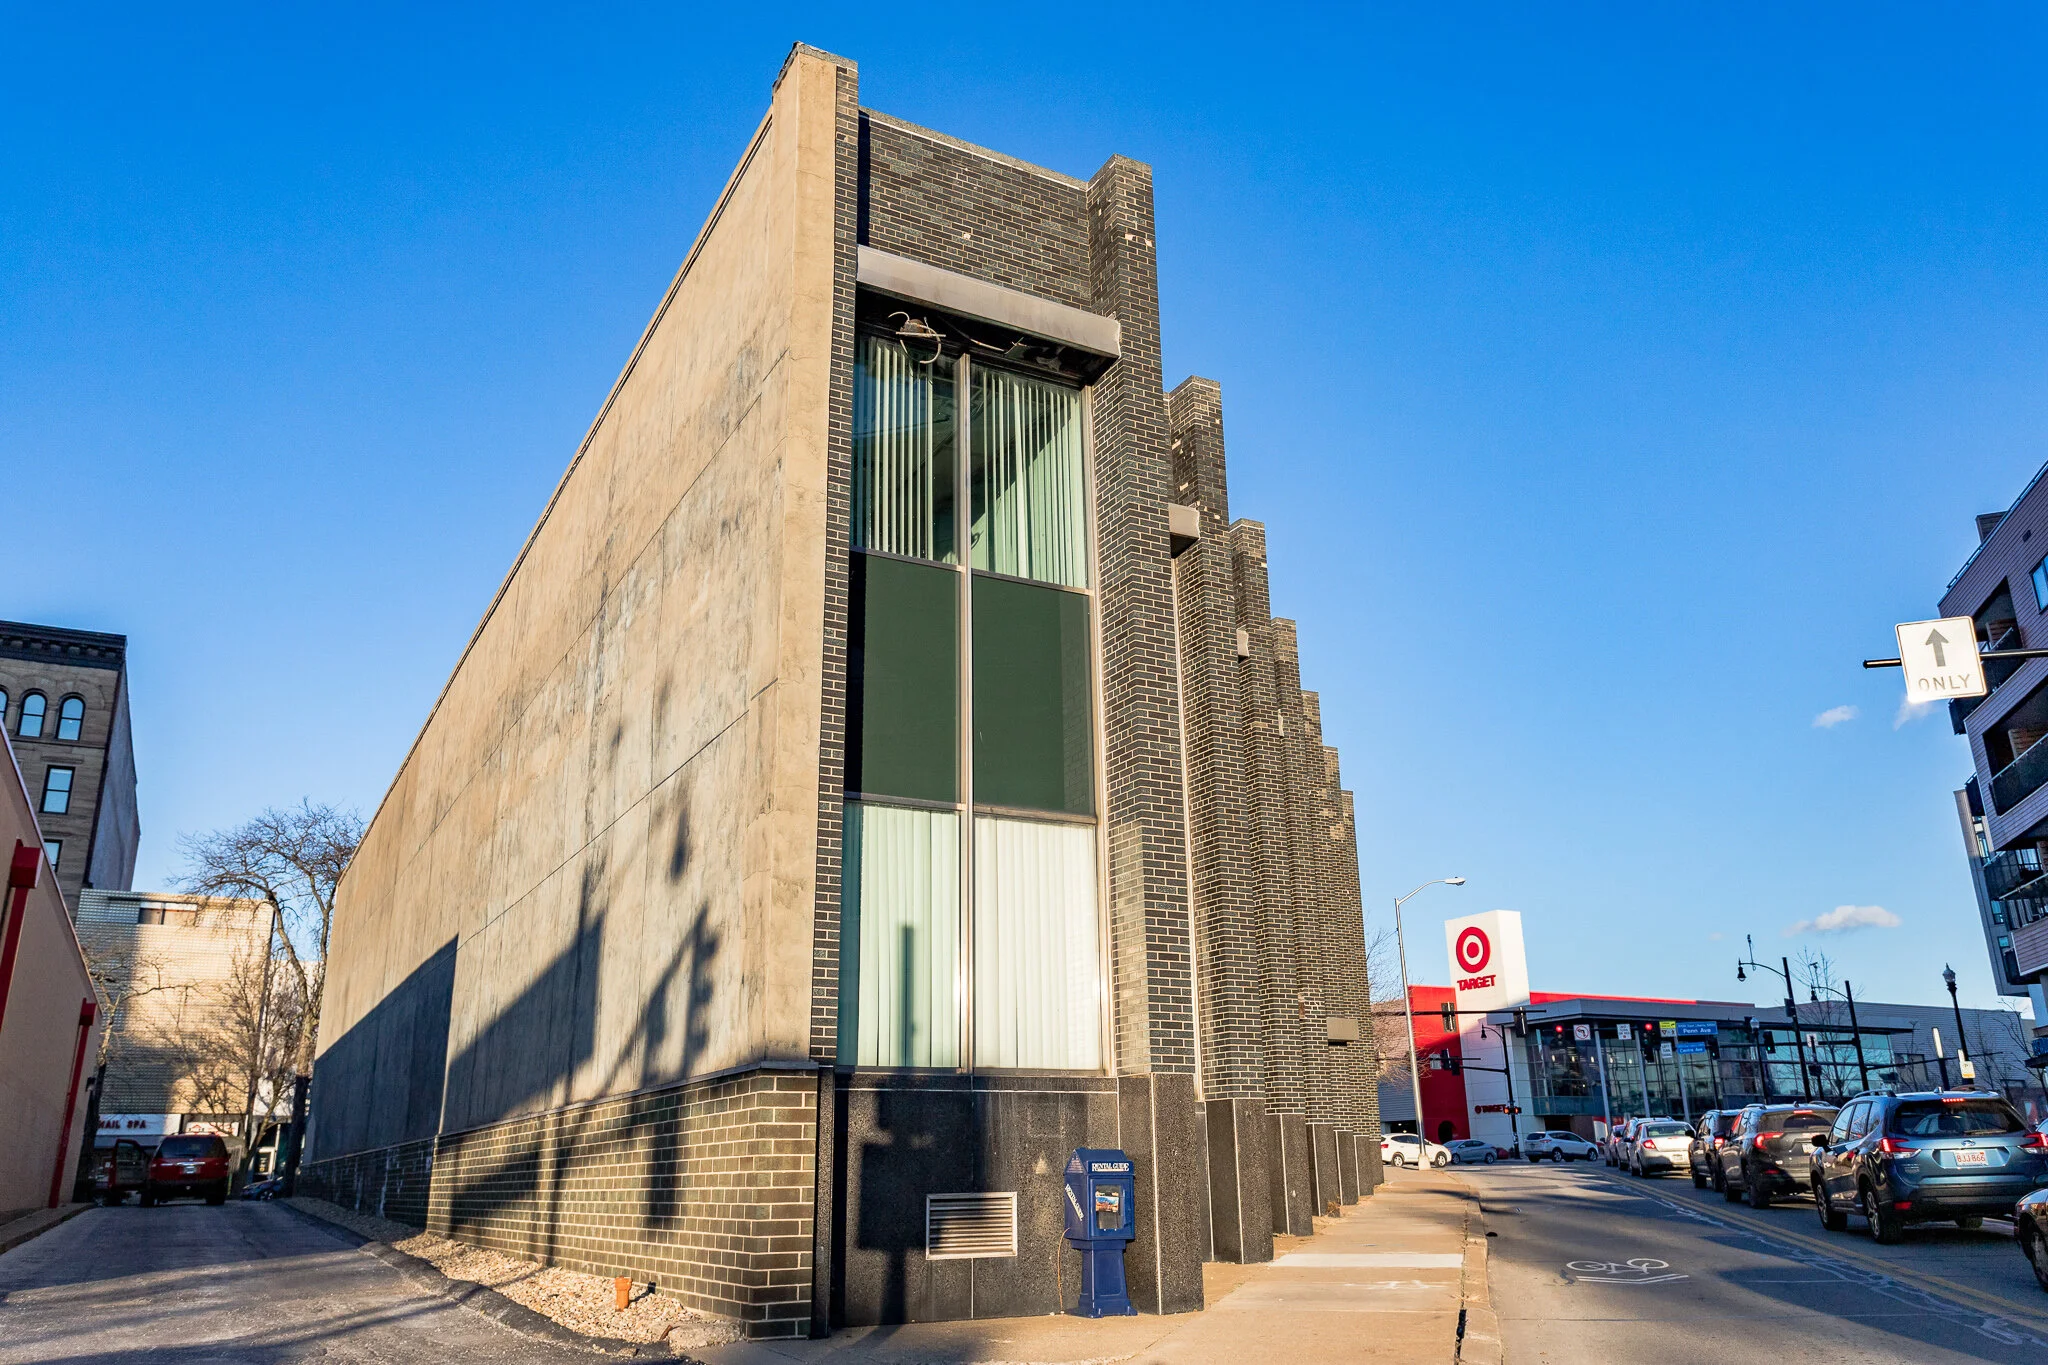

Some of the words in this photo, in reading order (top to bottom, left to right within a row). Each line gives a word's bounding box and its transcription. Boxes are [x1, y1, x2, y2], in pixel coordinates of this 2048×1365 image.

[1918, 674, 1970, 691] ONLY
[1457, 975, 1497, 991] TARGET
[127, 1120, 146, 1128] SPA
